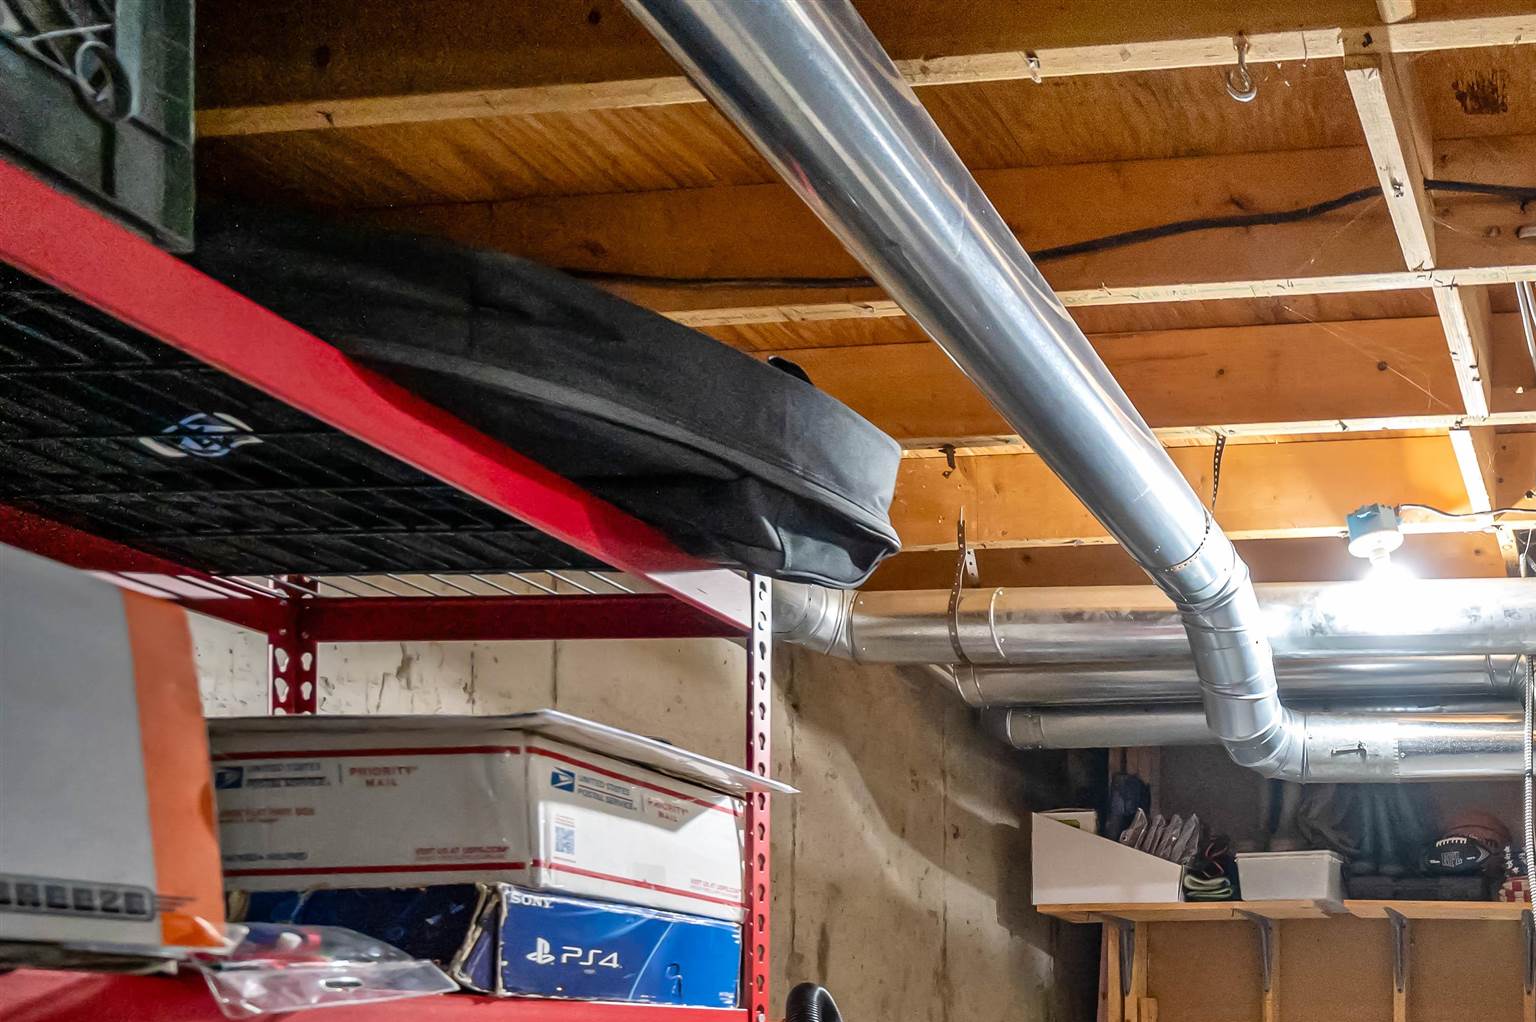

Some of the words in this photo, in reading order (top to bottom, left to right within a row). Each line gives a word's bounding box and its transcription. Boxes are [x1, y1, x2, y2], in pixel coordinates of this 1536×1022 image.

[350, 766, 416, 777] PRIORITY
[365, 778, 398, 788] MAIL
[510, 891, 553, 908] SONY
[561, 945, 621, 969] PS4
